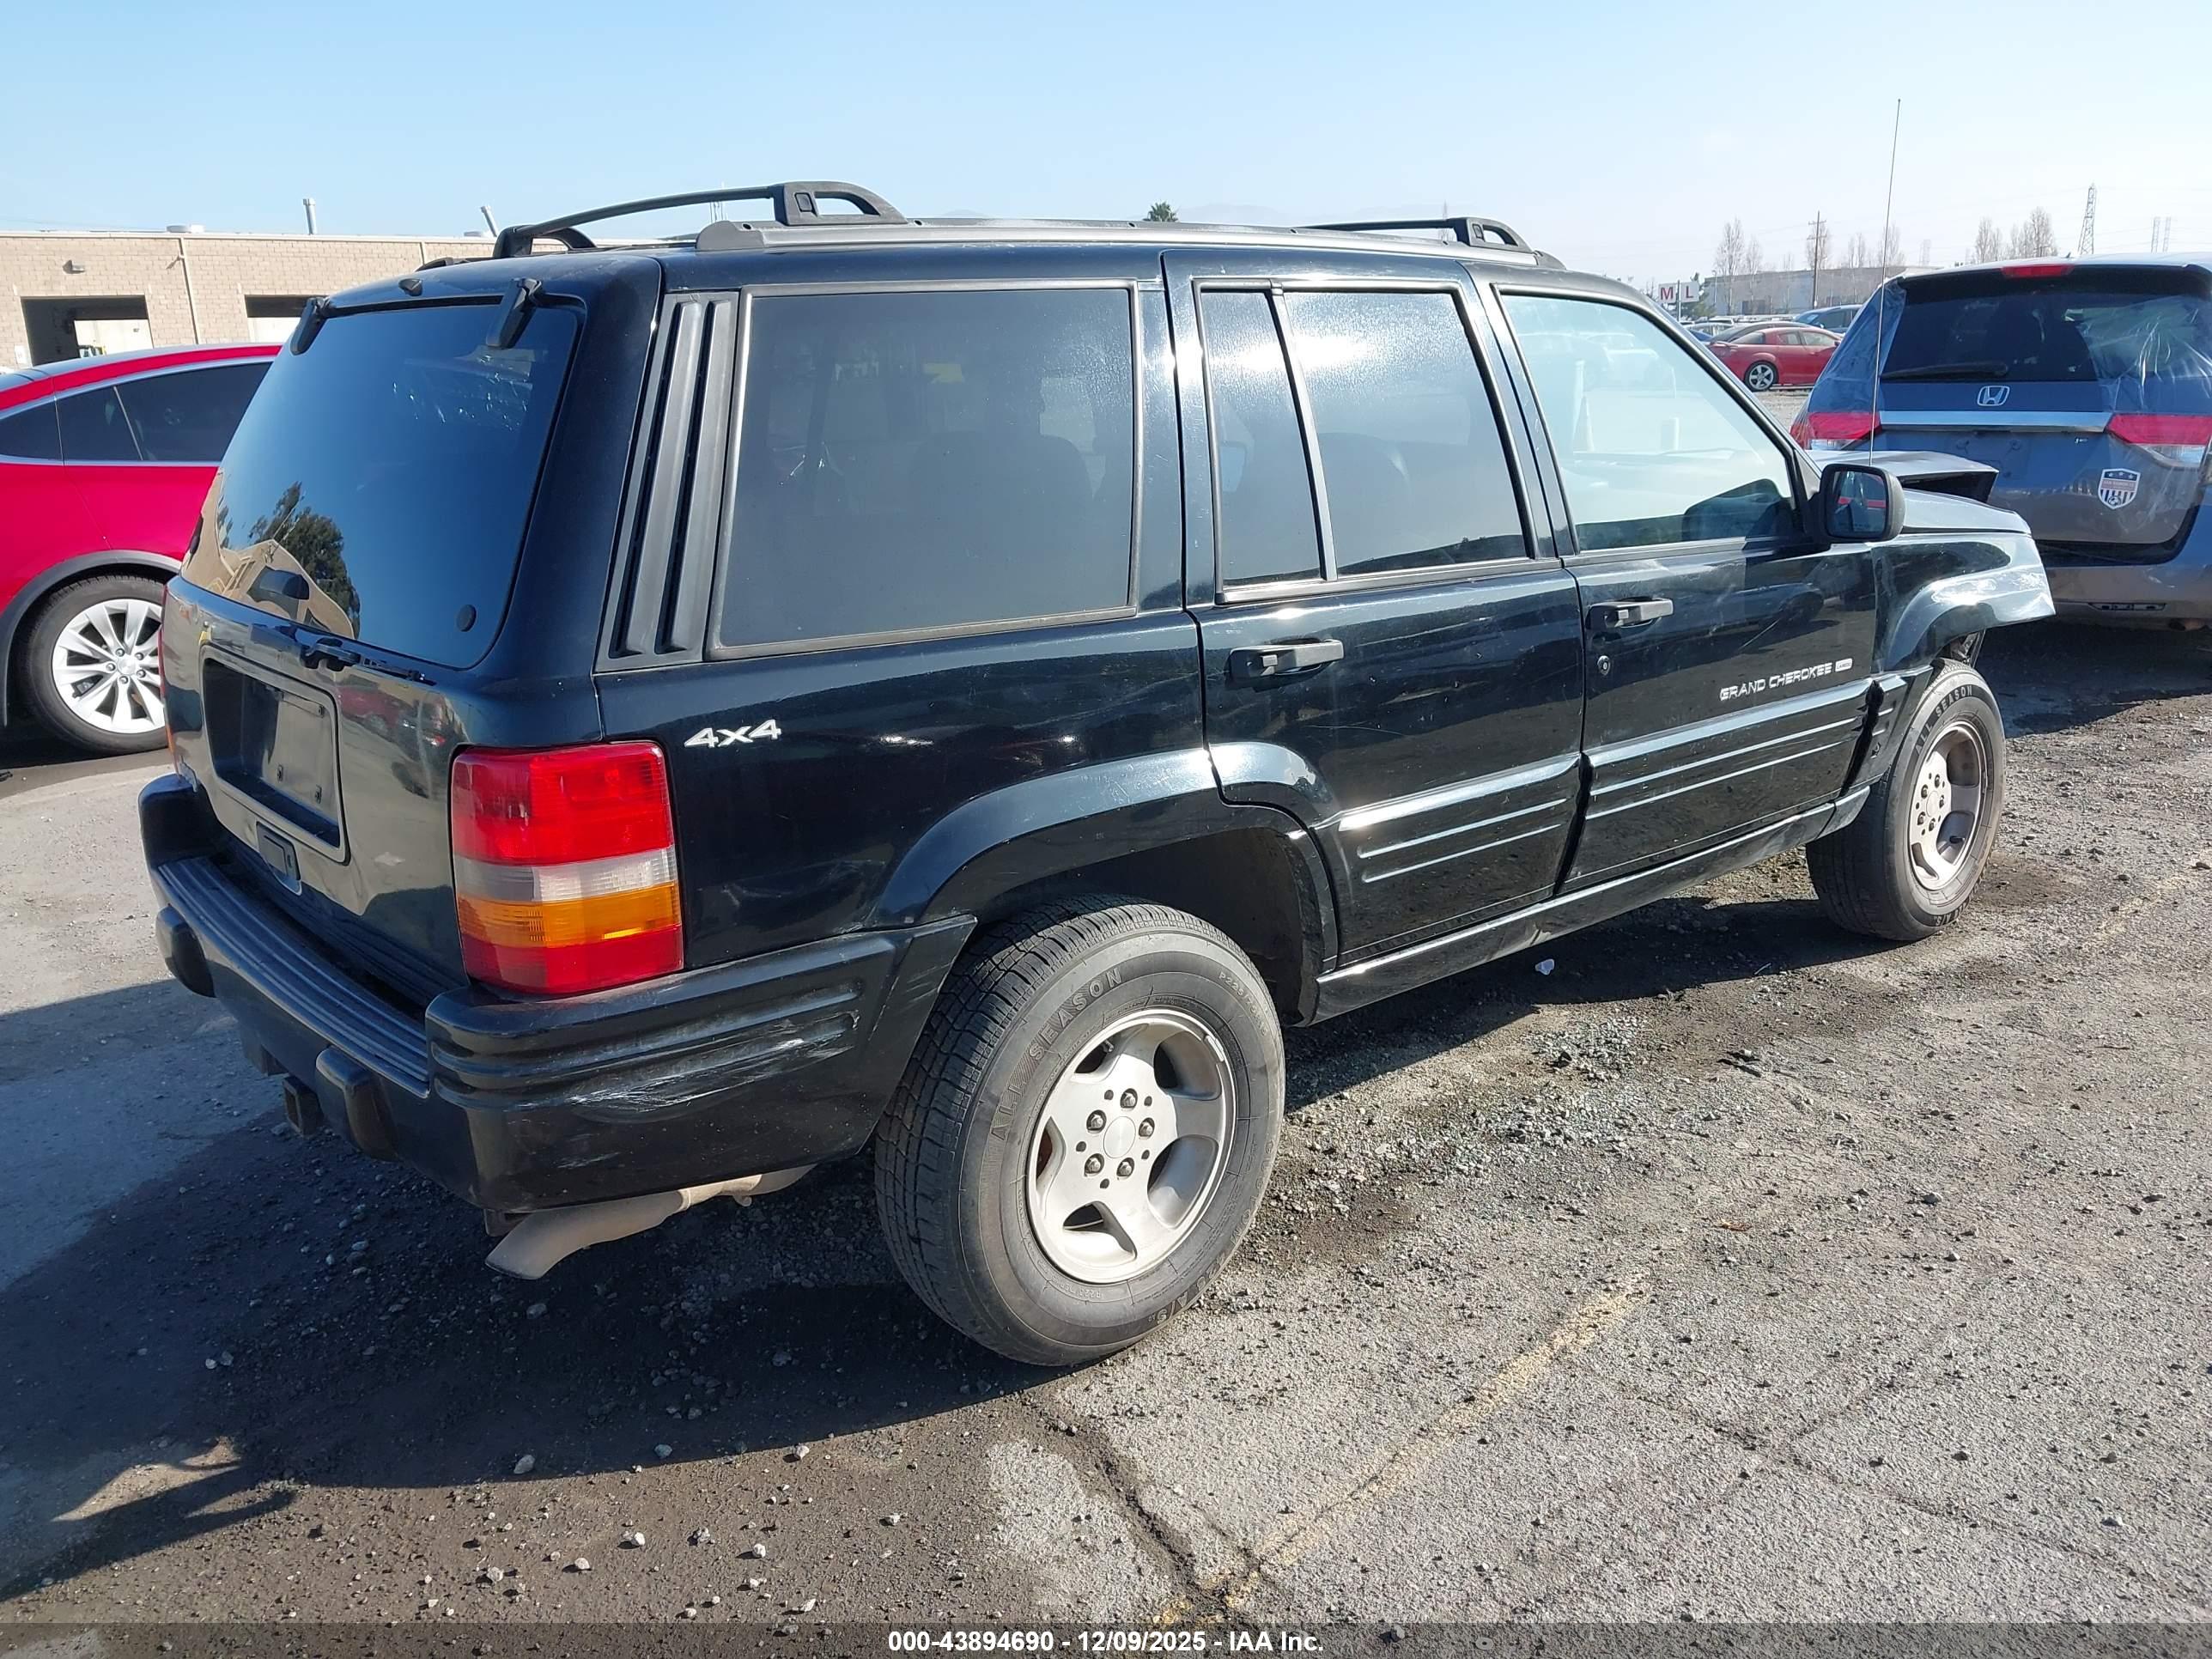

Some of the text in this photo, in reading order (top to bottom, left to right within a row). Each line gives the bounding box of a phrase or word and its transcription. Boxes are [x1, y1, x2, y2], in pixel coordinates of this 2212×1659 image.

[1660, 285, 1694, 301] M L
[1719, 678, 1766, 702] GRAND
[1769, 662, 1833, 689] CHEROKEE
[1915, 685, 1972, 756] ALL SEASON
[991, 1082, 1026, 1141] ALL
[1030, 968, 1123, 1060] SEASON
